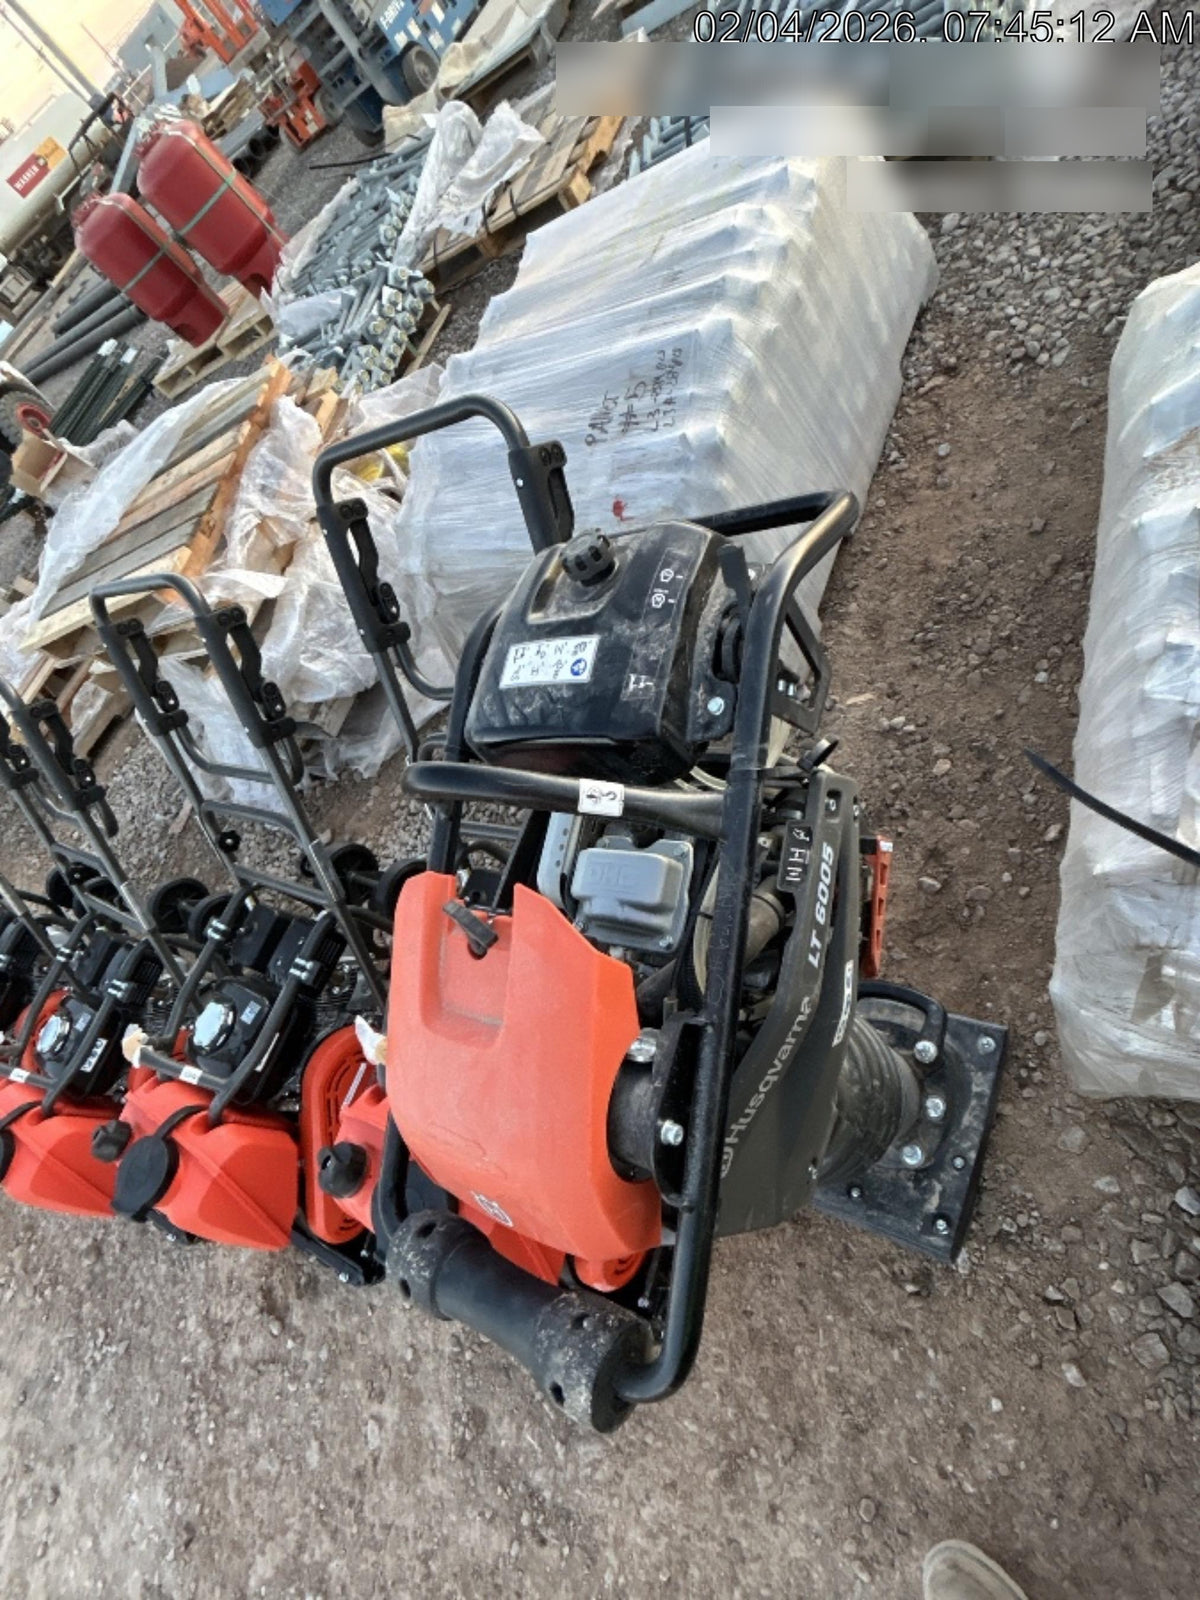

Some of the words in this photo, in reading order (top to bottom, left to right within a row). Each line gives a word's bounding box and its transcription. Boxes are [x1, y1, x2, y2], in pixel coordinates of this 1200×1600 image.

[815, 842, 835, 925] 6005
[808, 929, 823, 969] LT
[724, 996, 812, 1144] Husqvarna
